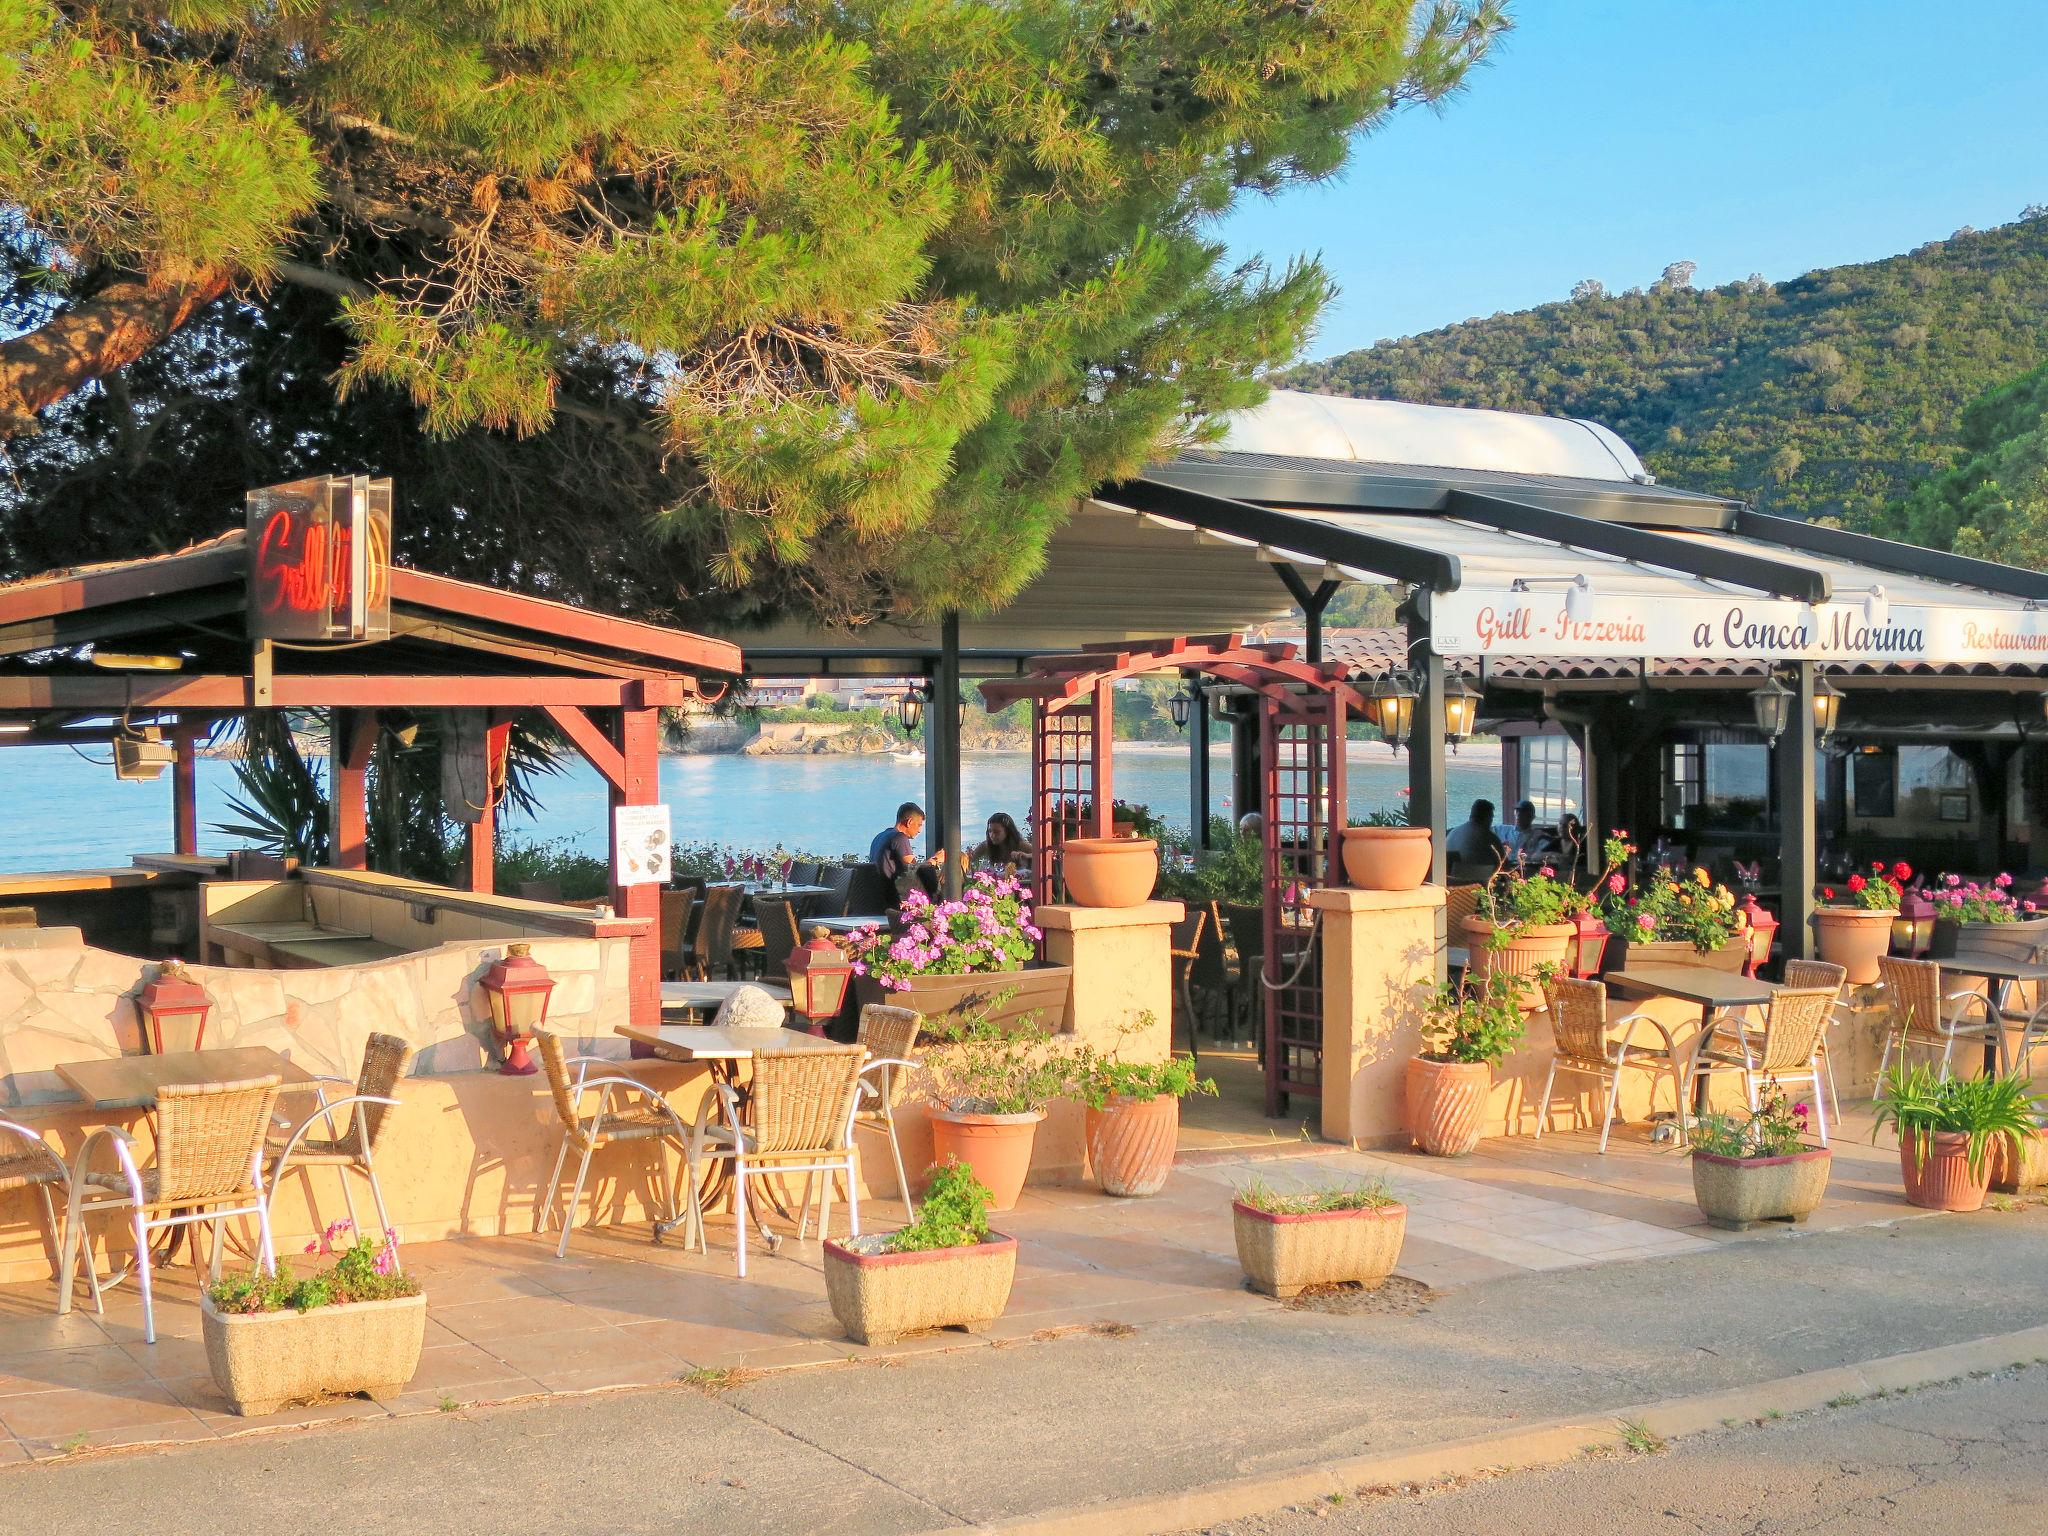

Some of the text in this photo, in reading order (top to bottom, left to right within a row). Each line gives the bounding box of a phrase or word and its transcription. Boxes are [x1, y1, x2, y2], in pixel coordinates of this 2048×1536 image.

[1476, 606, 1532, 650] Grill
[1554, 609, 1648, 643] Pizzeria
[1693, 607, 1925, 652] a Conca Marina
[1962, 621, 2048, 651] Restauran
